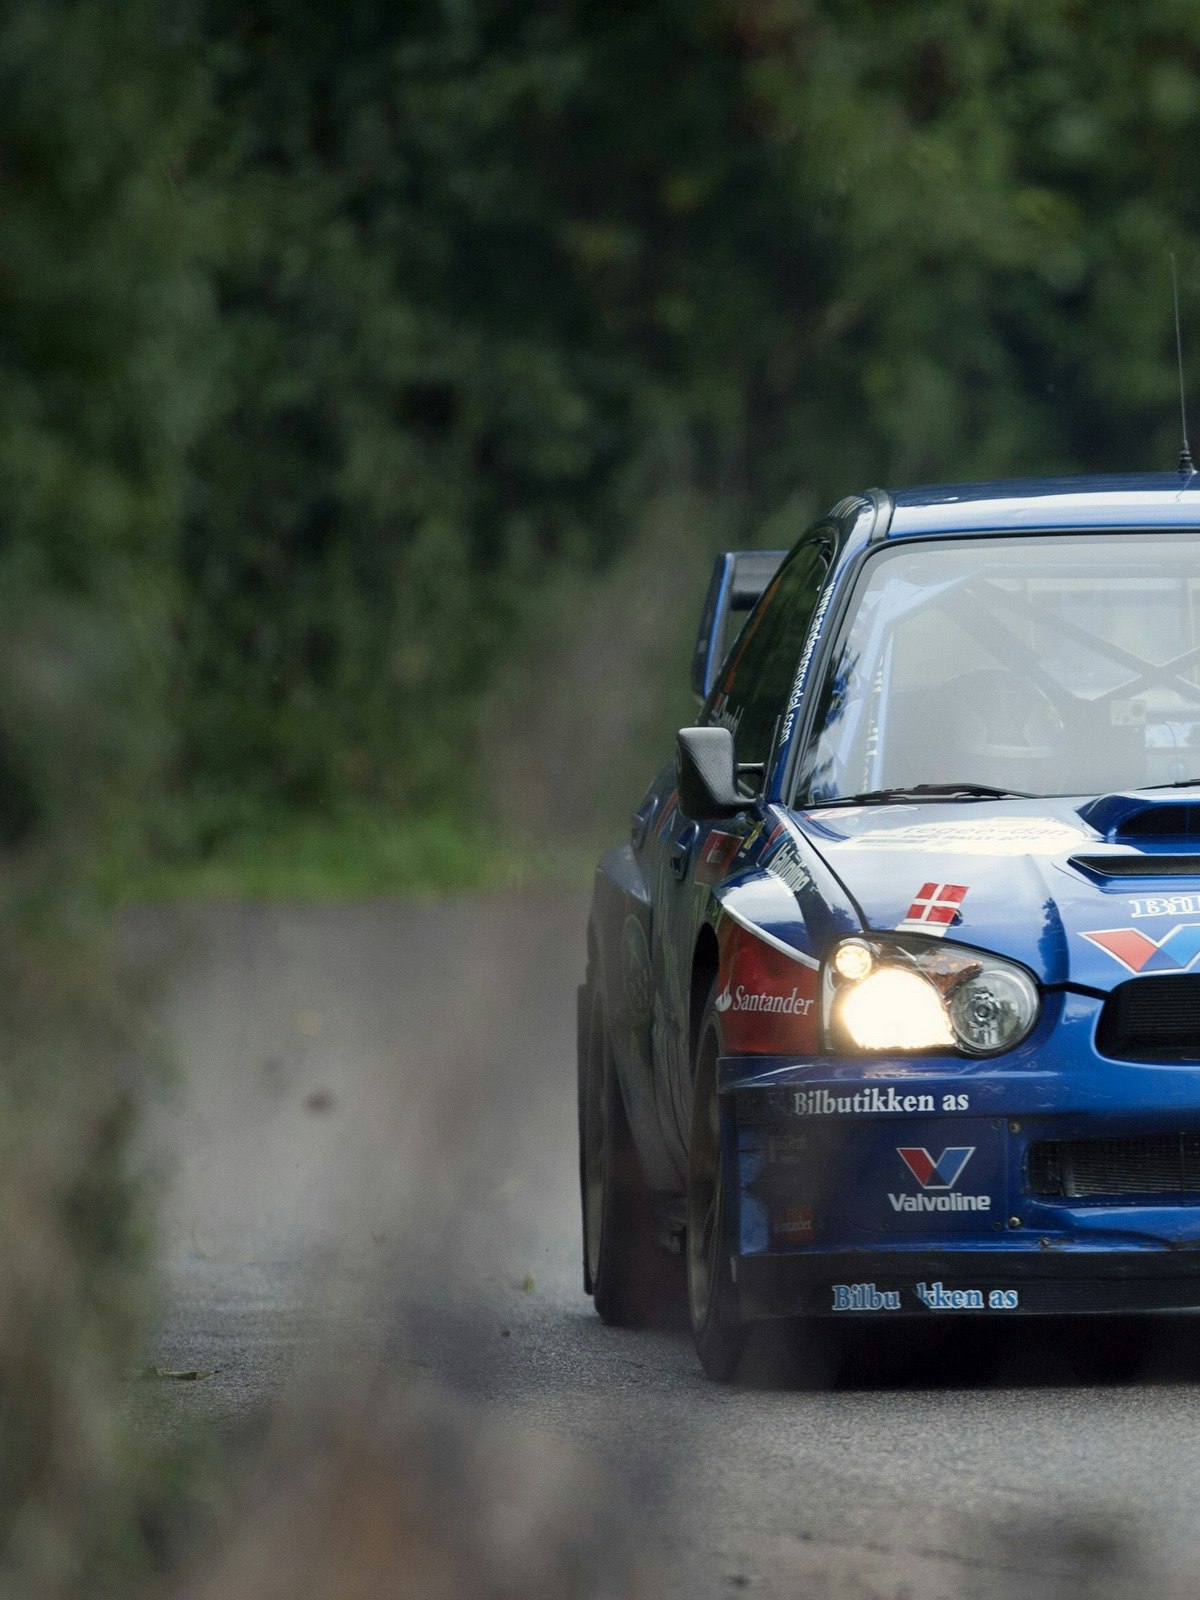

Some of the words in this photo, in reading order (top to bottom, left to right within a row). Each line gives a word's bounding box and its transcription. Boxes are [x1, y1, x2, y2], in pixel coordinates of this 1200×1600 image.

[733, 985, 815, 1016] Santander
[793, 1087, 936, 1115] Bilbutikken
[942, 1094, 969, 1111] as
[887, 1192, 991, 1211] Valvoline
[831, 1281, 985, 1311] Bilbukken
[988, 1289, 1019, 1309] as
